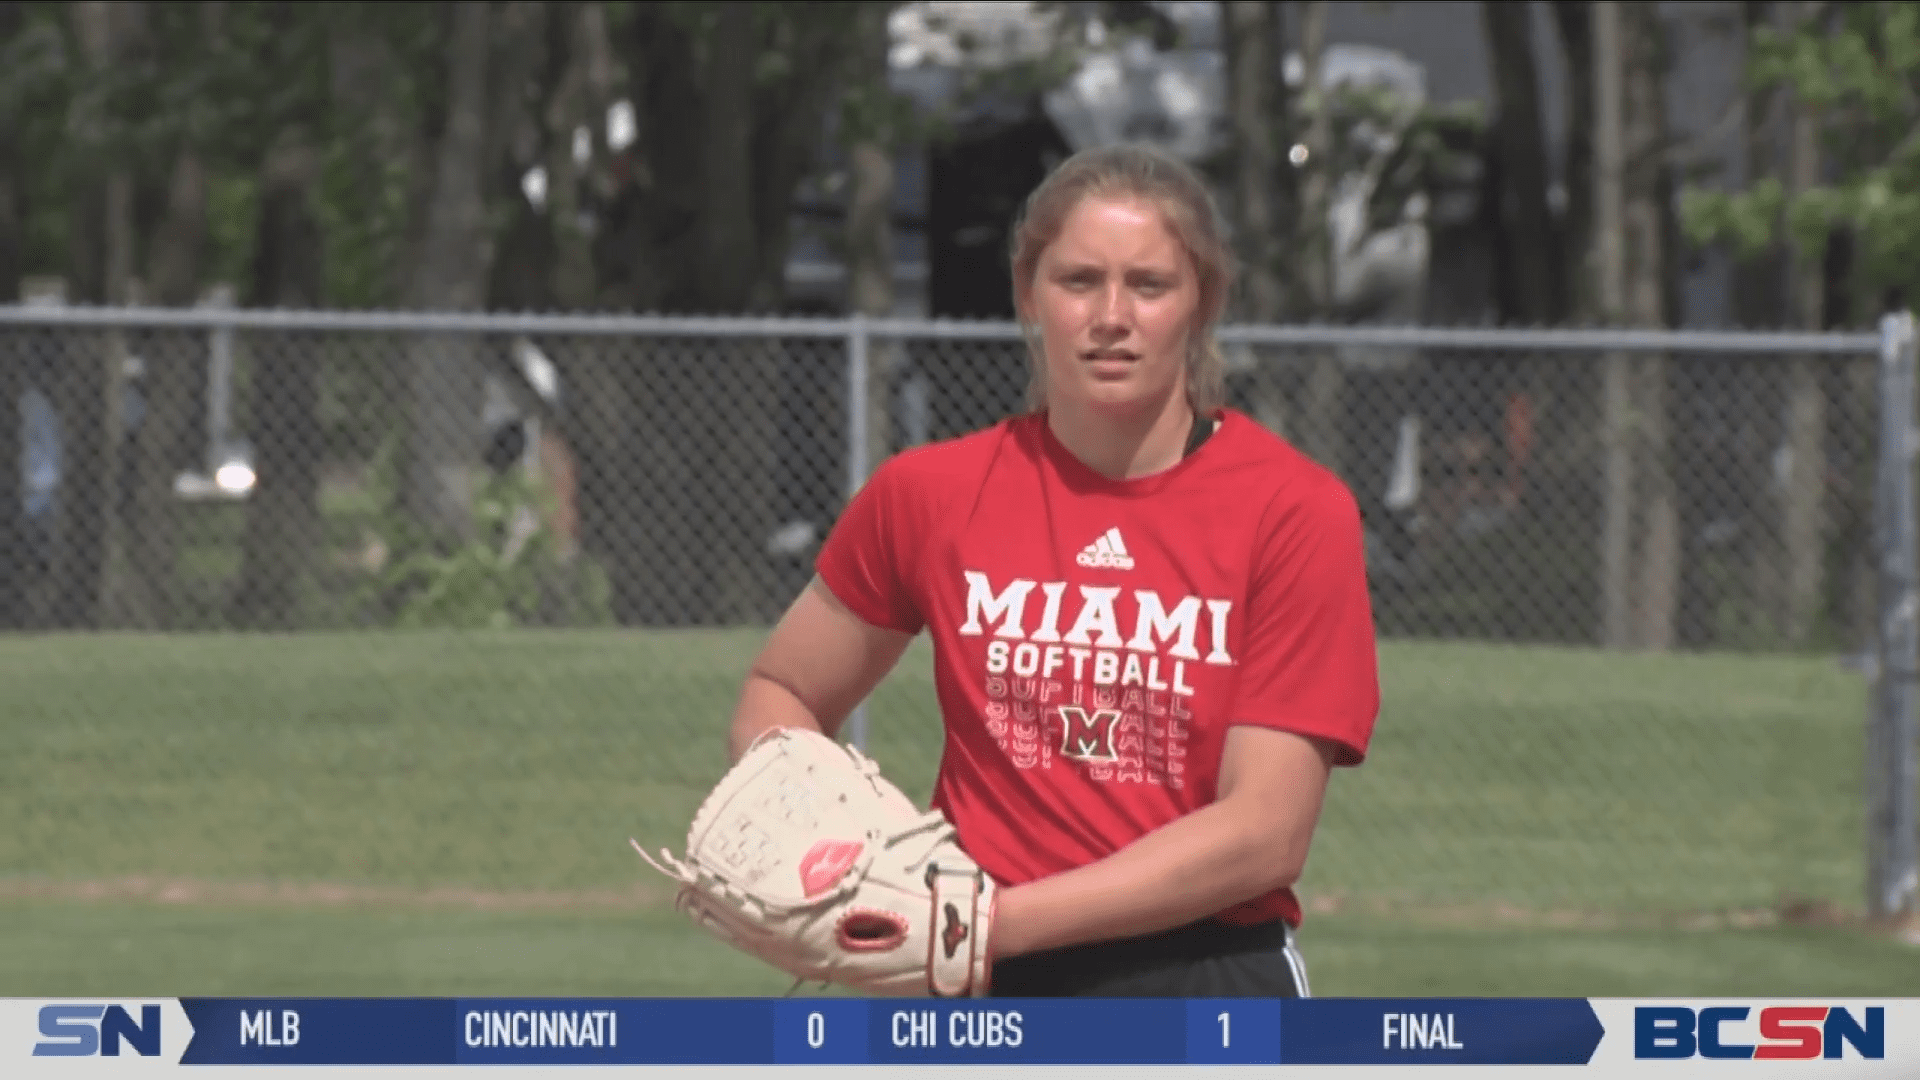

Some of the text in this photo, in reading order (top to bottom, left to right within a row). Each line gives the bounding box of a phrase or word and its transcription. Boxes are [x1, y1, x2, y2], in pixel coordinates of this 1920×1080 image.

[1076, 552, 1135, 570] adidas
[958, 570, 1232, 665] MIAMI
[986, 641, 1195, 696] SOFTBALL
[1058, 705, 1122, 762] M
